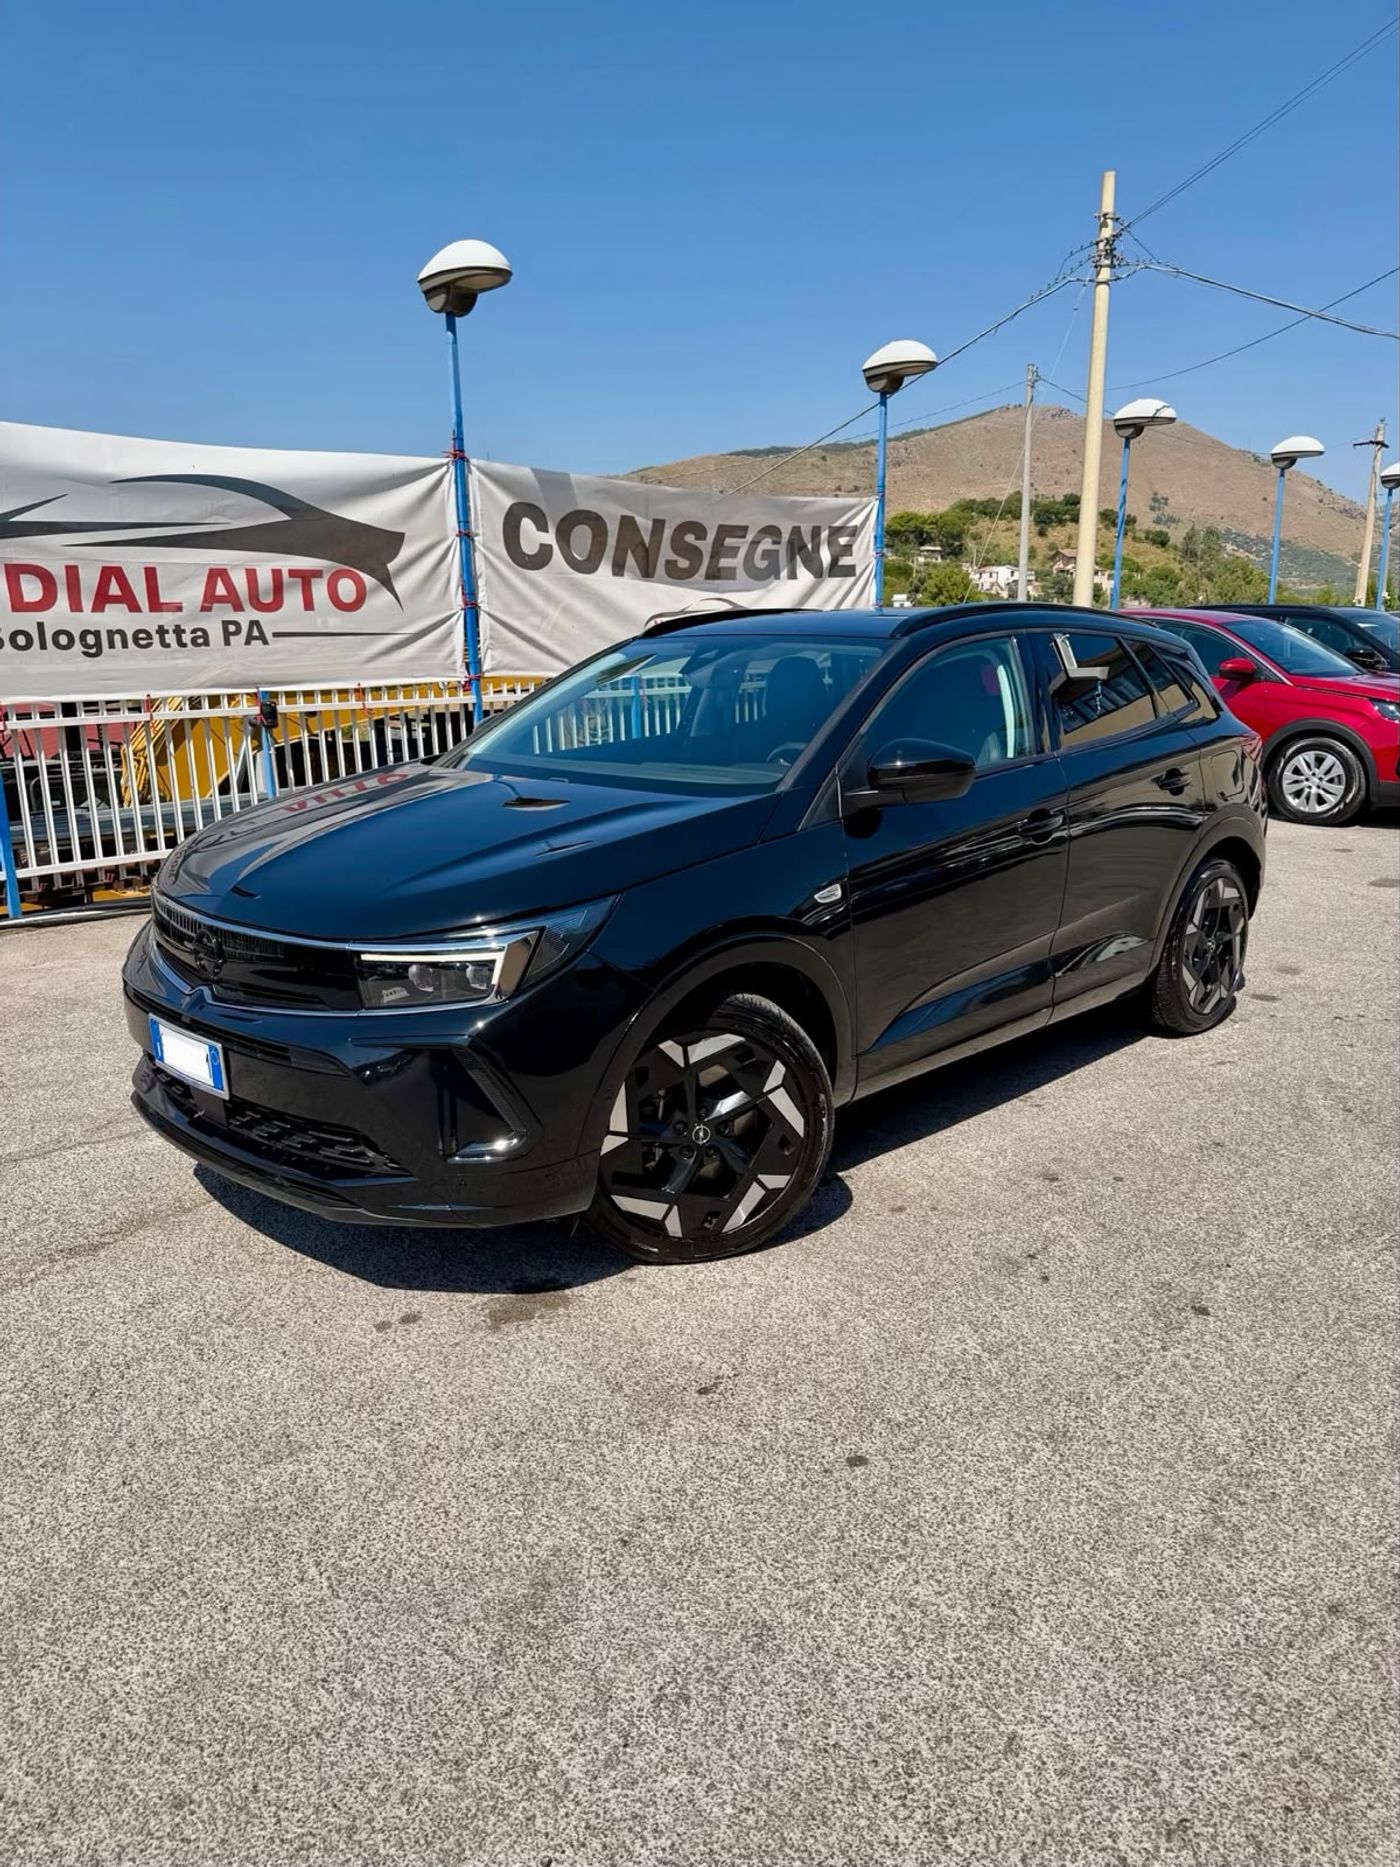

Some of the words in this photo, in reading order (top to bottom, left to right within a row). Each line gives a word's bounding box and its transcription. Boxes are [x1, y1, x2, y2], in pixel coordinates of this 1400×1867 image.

[502, 501, 858, 581] CONSEGNE
[3, 563, 183, 613] DIAL
[200, 568, 367, 613] AUTO
[222, 619, 270, 647] PA
